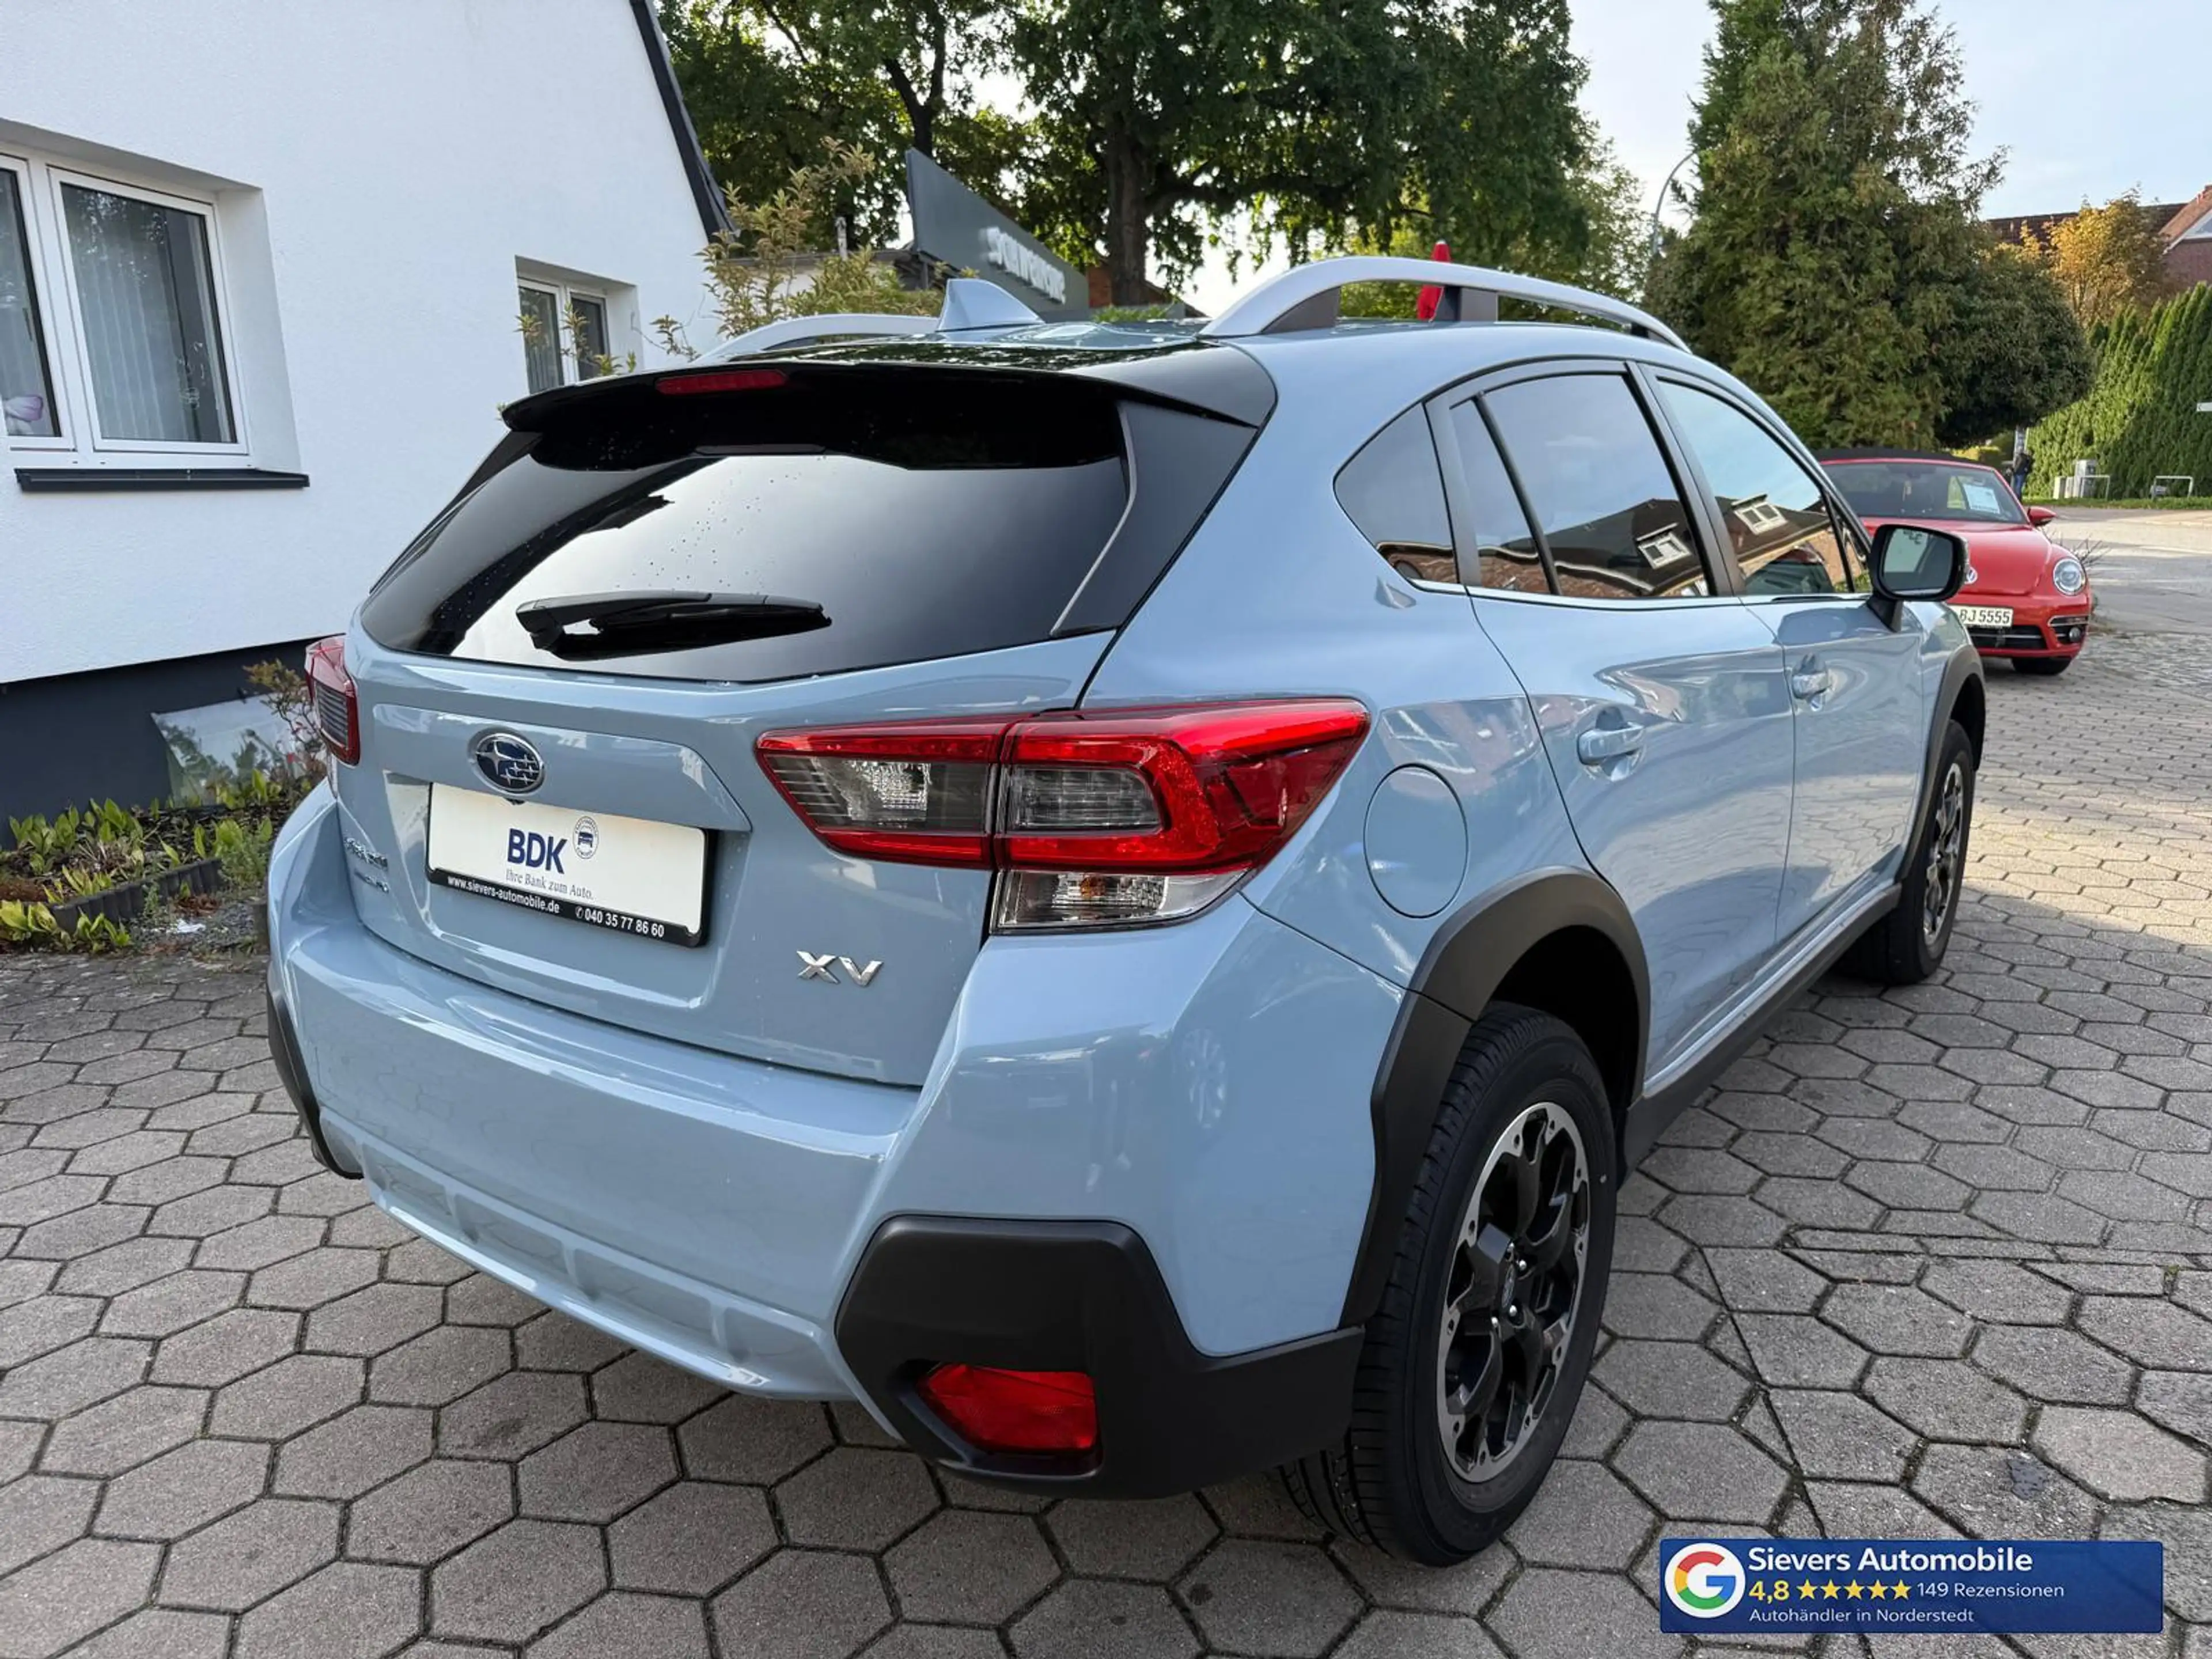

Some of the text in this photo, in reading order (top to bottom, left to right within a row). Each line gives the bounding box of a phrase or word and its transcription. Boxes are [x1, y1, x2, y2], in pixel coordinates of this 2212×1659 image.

[1978, 609, 2010, 624] 5555
[507, 828, 568, 874] BDK
[448, 876, 560, 914] www.sievers-automobile.de
[506, 868, 594, 900] Ihre Bank zum Auto.
[585, 908, 665, 938] 040 35 77 86 60
[796, 950, 884, 987] XV
